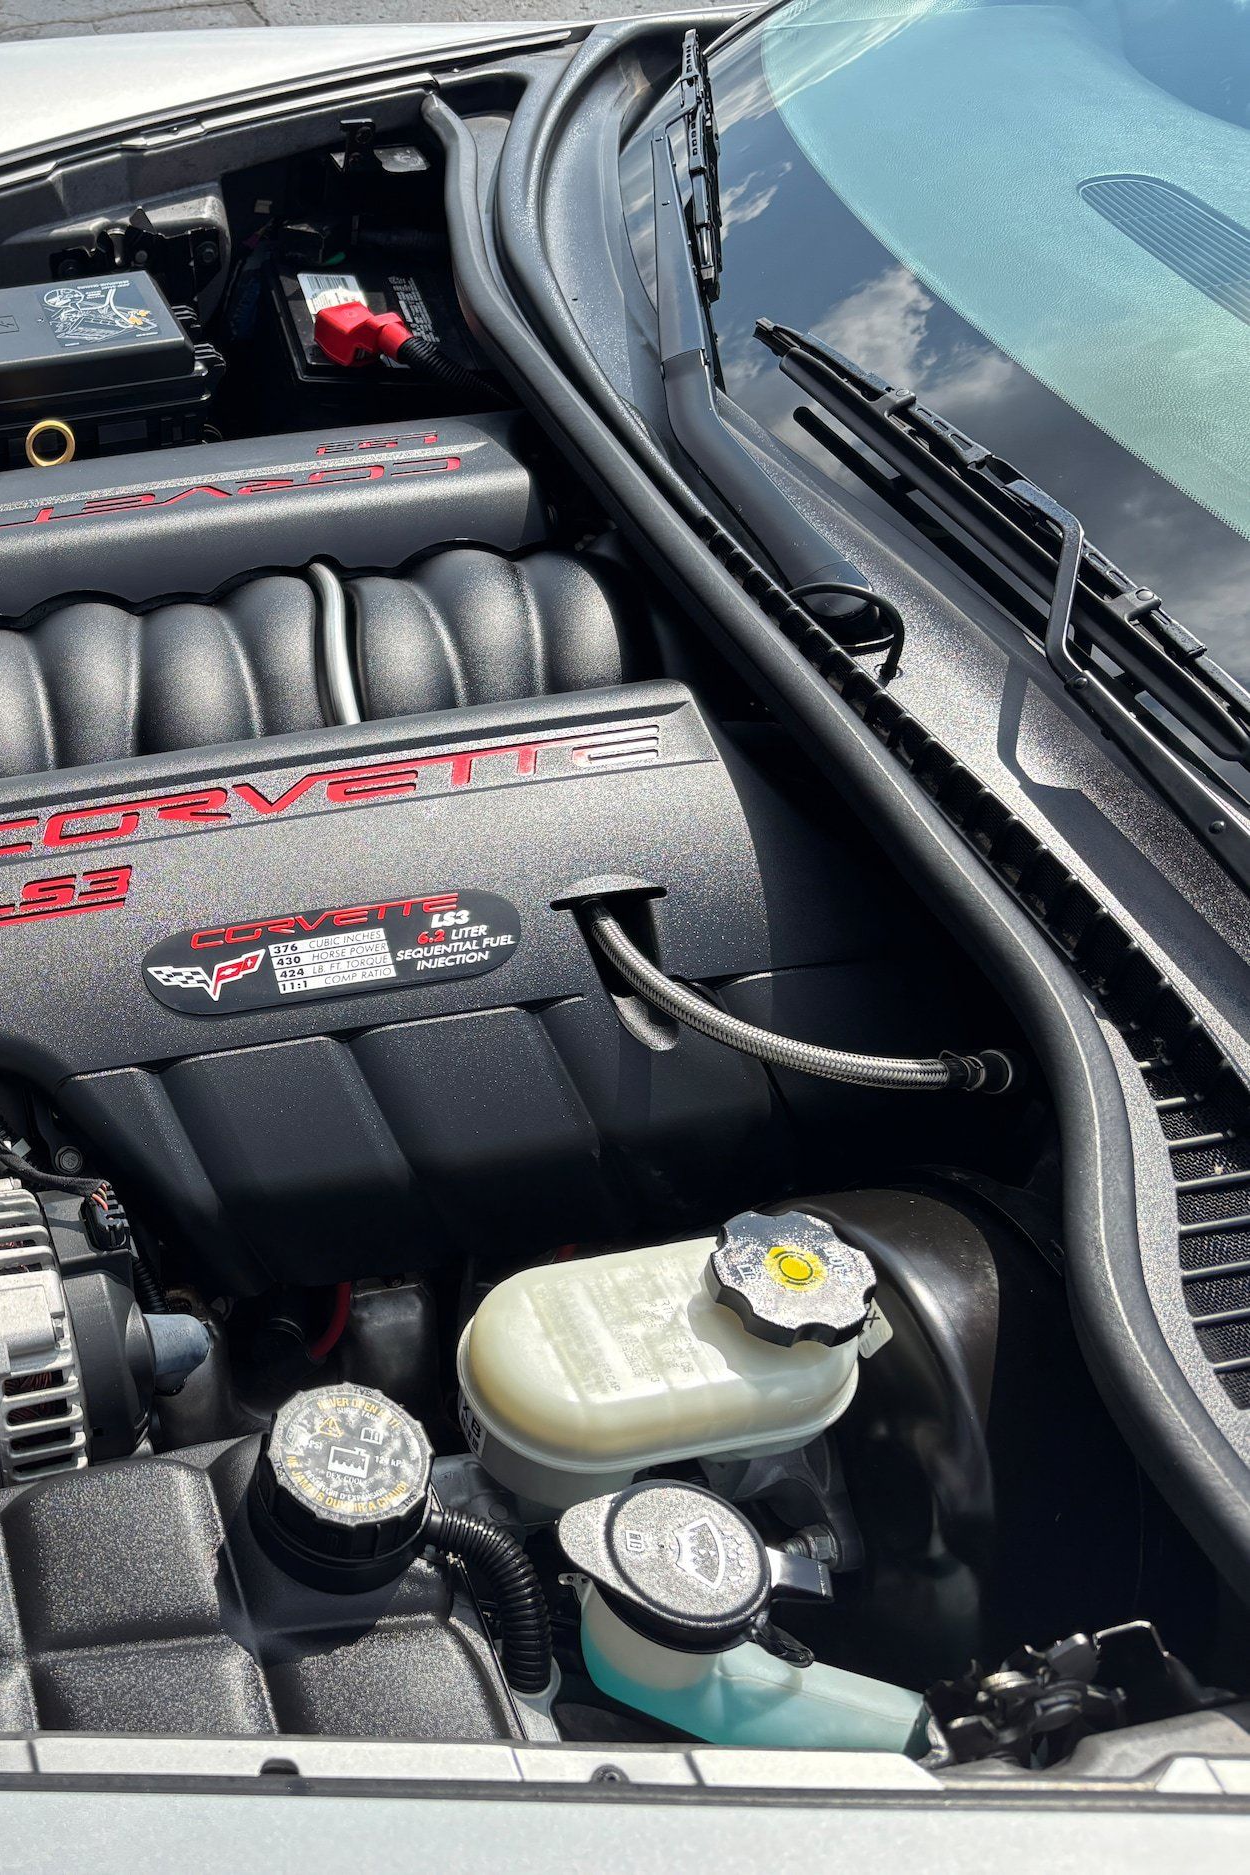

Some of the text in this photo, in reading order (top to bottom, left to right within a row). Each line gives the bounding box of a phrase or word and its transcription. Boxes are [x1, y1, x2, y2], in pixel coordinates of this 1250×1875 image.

[191, 893, 459, 950] CORVETTE
[430, 909, 470, 929] LS3
[273, 930, 382, 954] 376 CUBIC INCHES
[416, 925, 488, 945] 6.2 LITER
[276, 942, 386, 966] 430 HORSE POWER
[395, 934, 515, 962] SEQUENTIAL FUEL
[280, 954, 389, 979] 424 LB. FT. TORQUE
[416, 951, 489, 971] INJECTION
[280, 967, 392, 992] 11:1 COMP RATIO
[317, 1398, 349, 1411] NEVER
[351, 1398, 379, 1414] OPEN
[291, 1470, 324, 1503] JAMAIS
